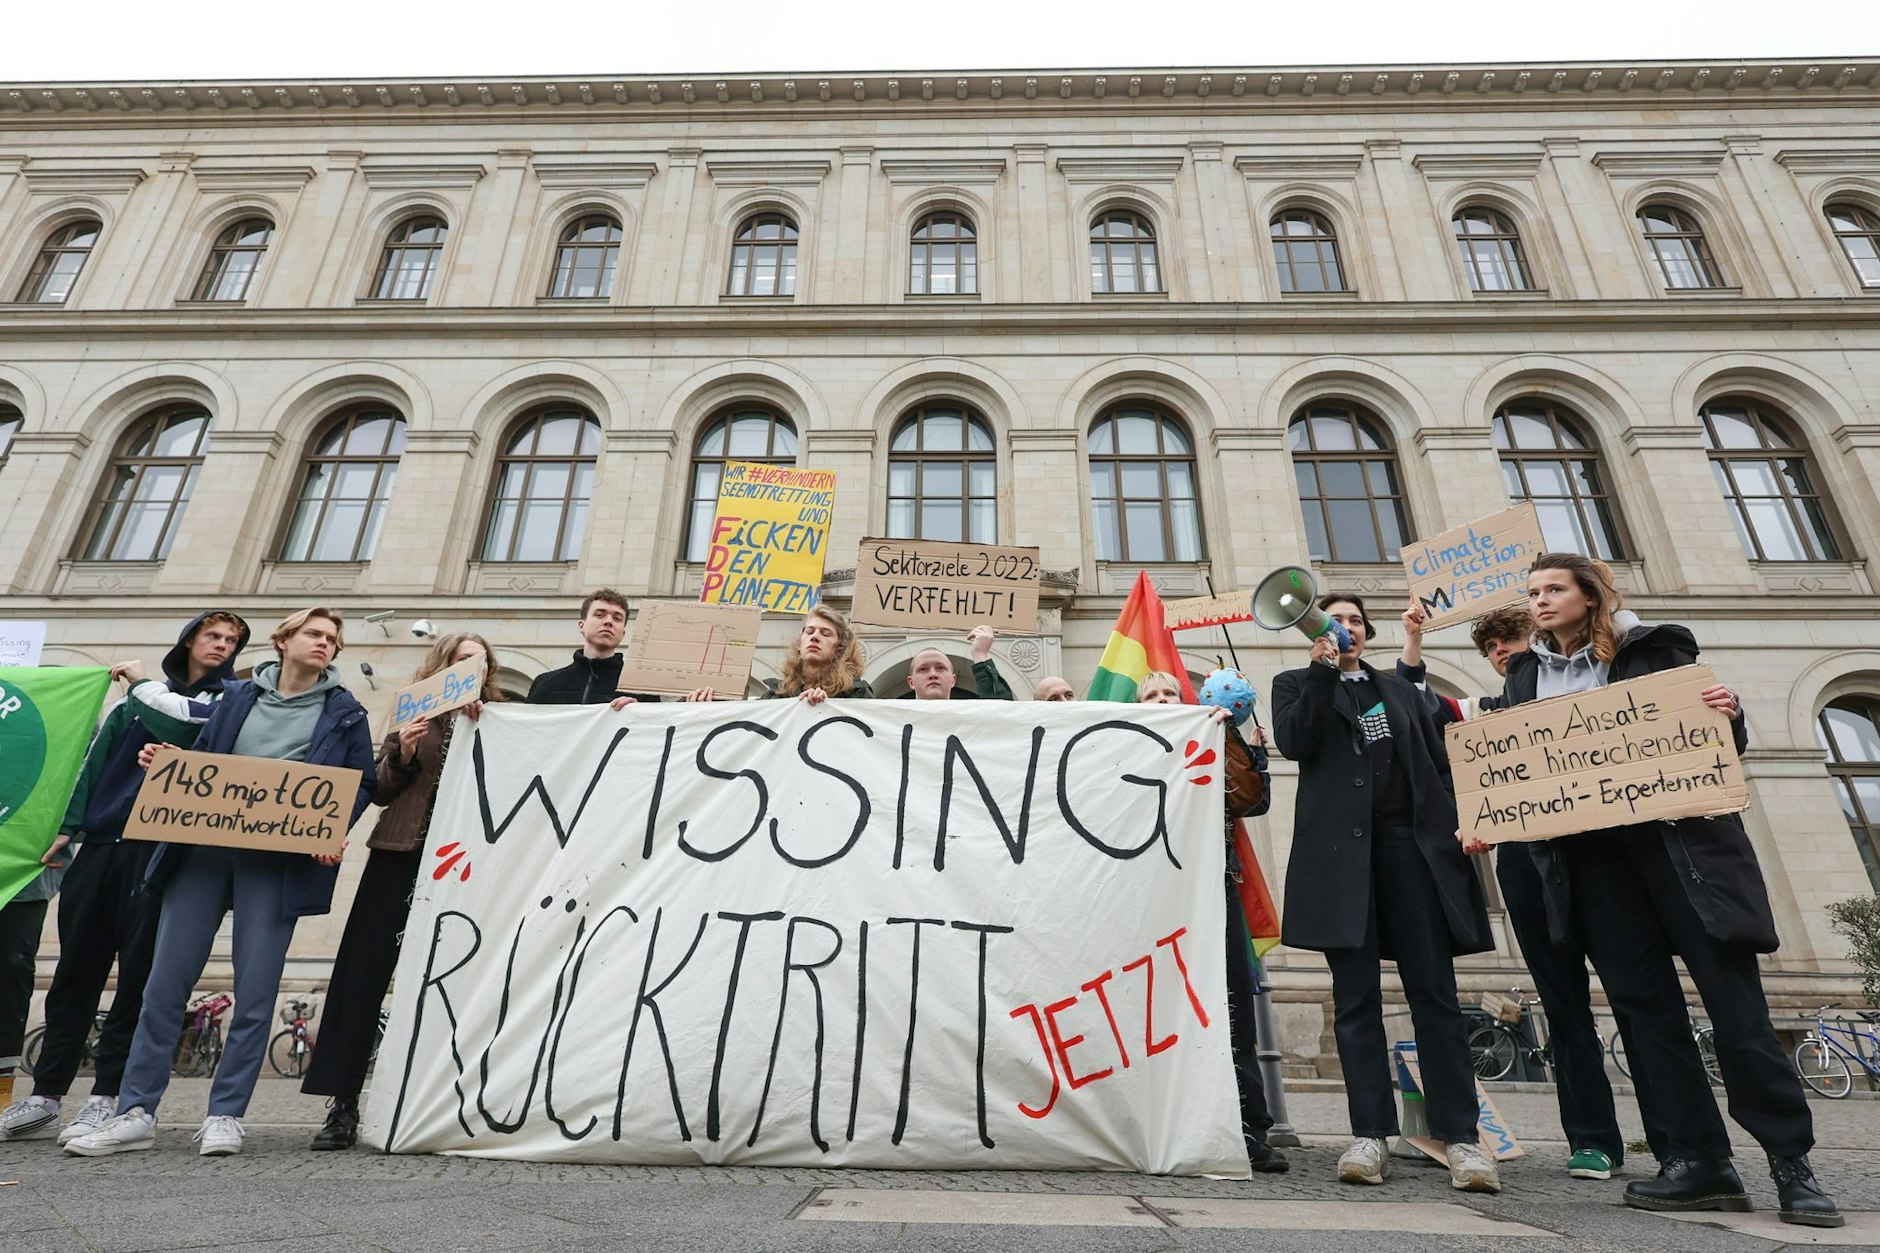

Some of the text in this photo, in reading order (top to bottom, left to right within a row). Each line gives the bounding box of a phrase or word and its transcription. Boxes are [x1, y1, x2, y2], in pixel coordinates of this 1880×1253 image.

[720, 481, 833, 507] SEENOTRETTUNG
[725, 465, 836, 489] WIR #VERHINDERN
[797, 507, 829, 525] UND
[706, 545, 772, 576] DEN
[873, 545, 1039, 581] Sektorziele 2022:
[1452, 540, 1534, 577] action:
[700, 572, 823, 612] PLANETEN
[0, 636, 31, 653] issing
[1524, 722, 1553, 745] im
[1563, 690, 1661, 739] Ansatz
[151, 758, 219, 798] 148
[1479, 762, 1531, 788] ohne
[1598, 752, 1732, 815] Expertenrat
[471, 715, 1183, 872] WISSING
[139, 804, 333, 840] unverantwortlich
[385, 894, 1015, 1154] RÜCKTRITT
[1009, 926, 1212, 1119] JETZT
